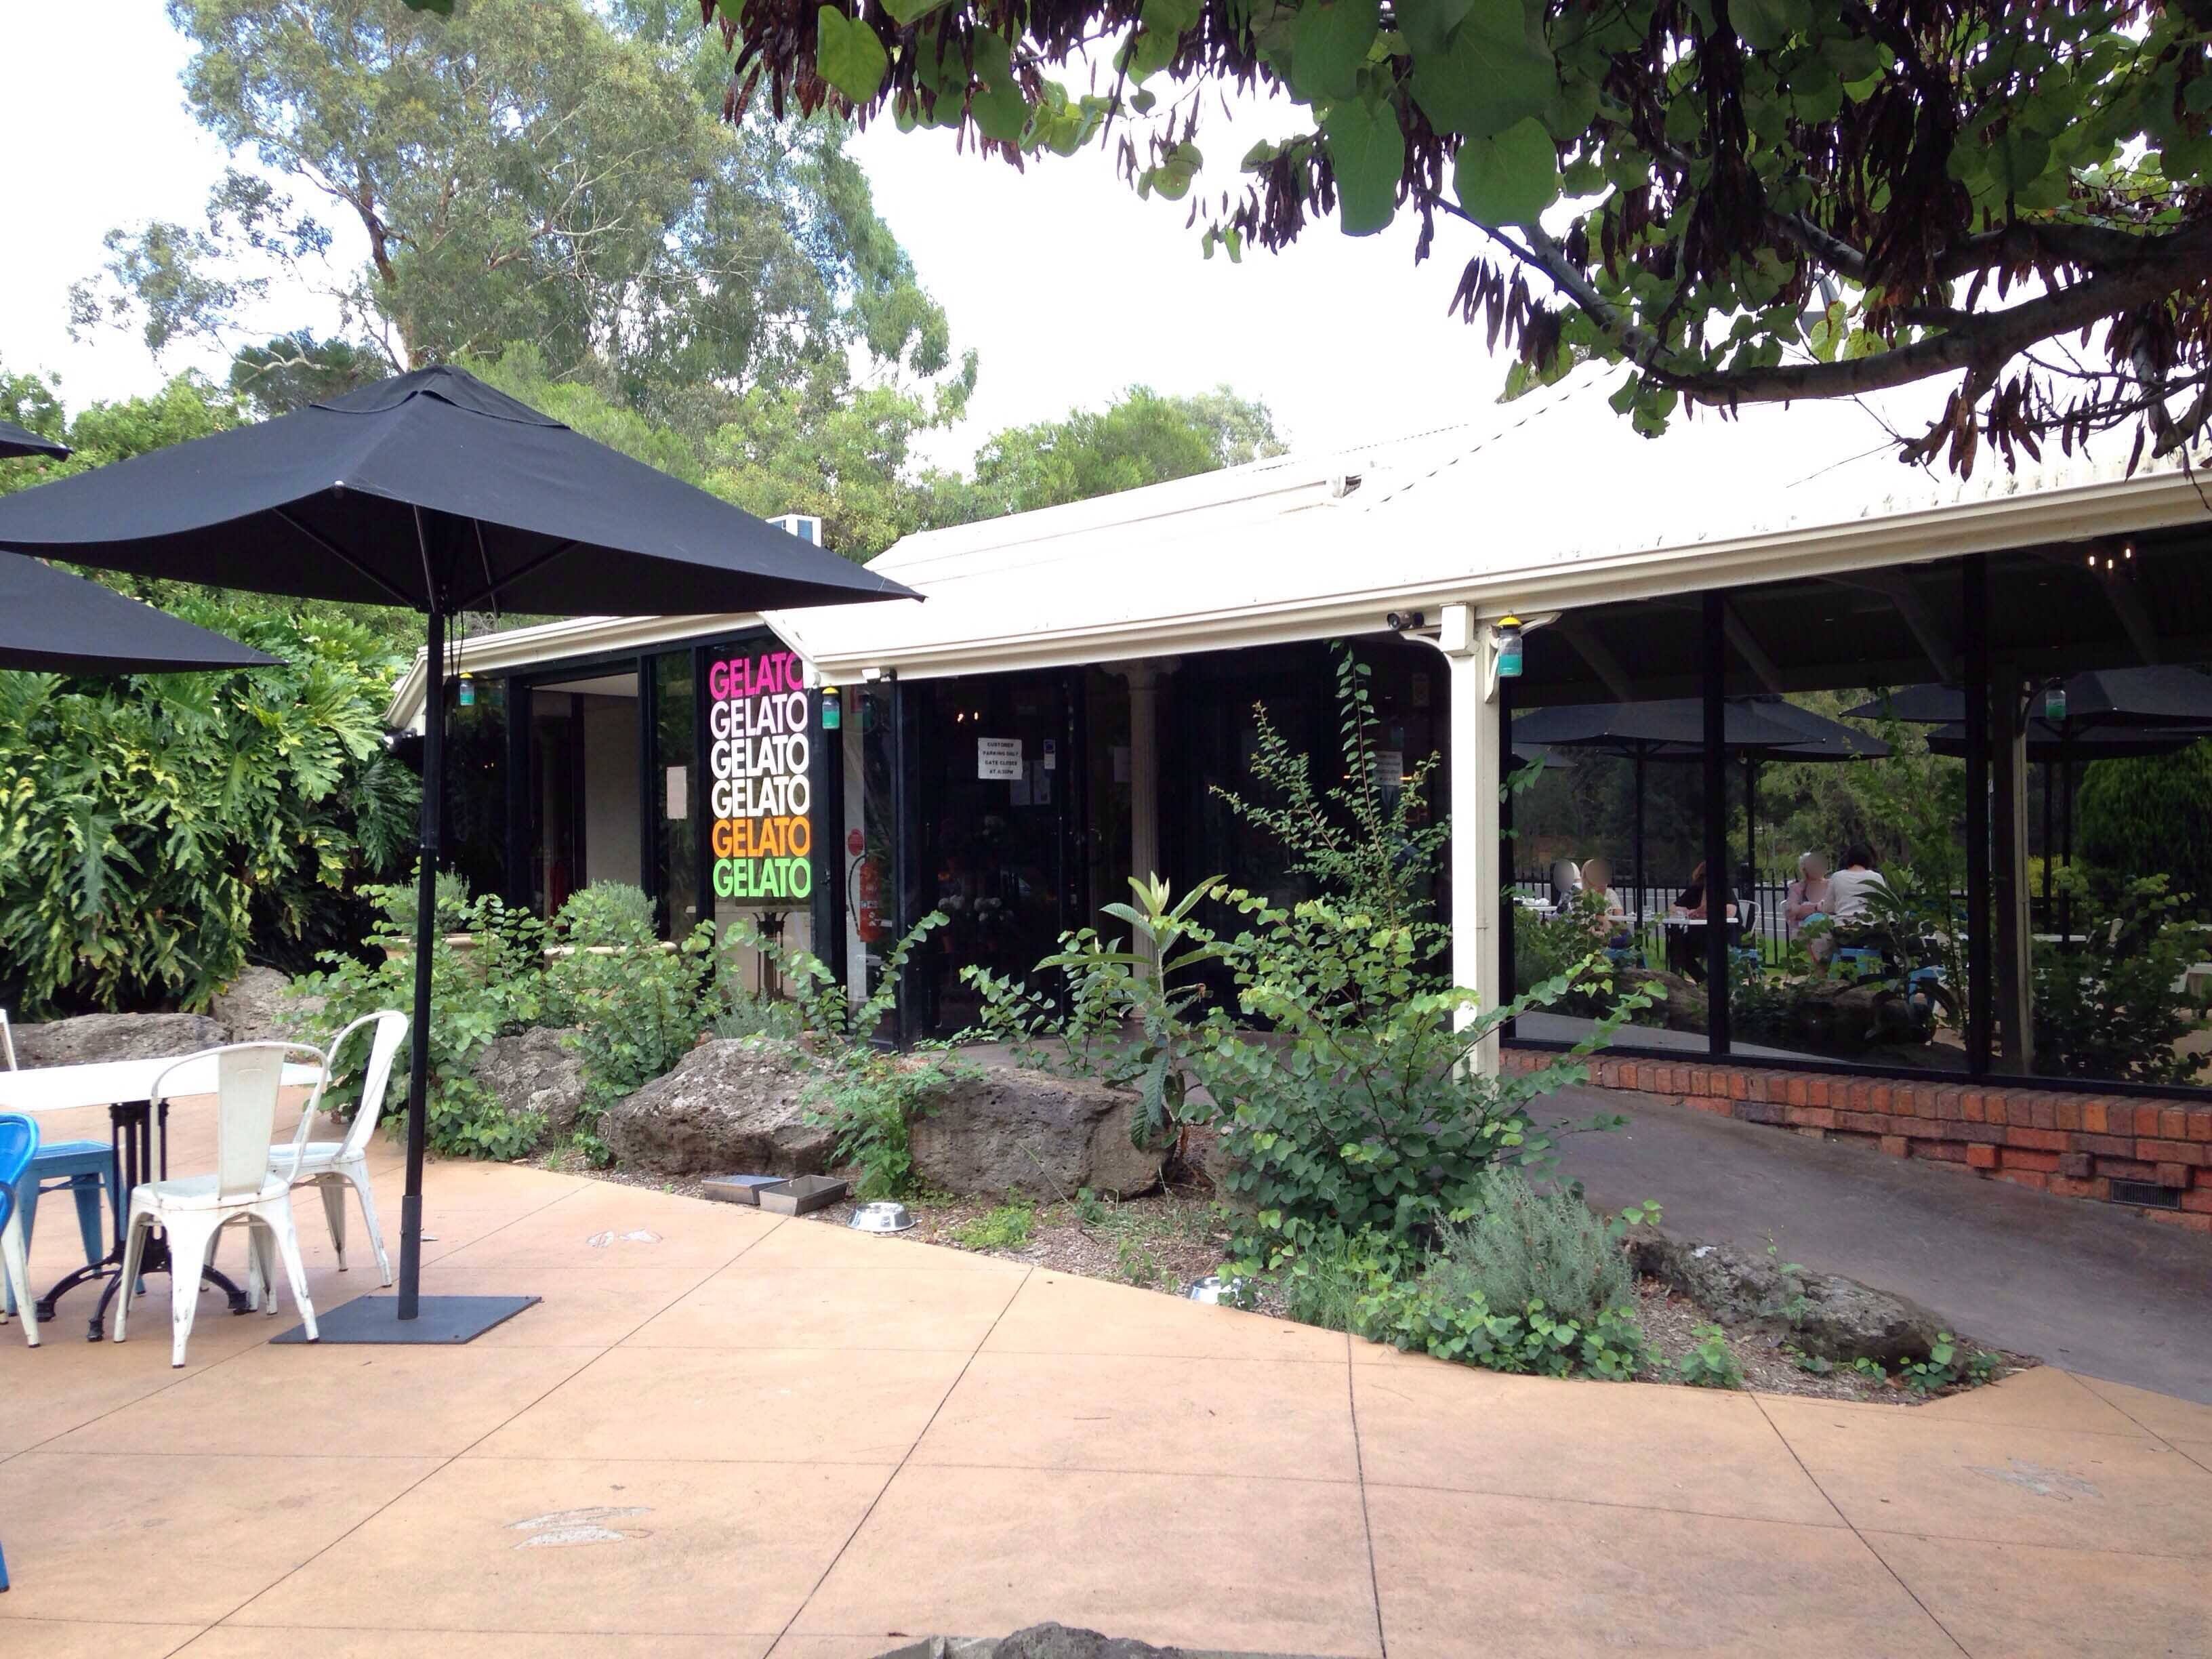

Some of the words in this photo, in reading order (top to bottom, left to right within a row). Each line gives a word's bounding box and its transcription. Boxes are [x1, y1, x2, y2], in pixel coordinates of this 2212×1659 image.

[710, 651, 803, 701] GELATO
[710, 691, 808, 740] GELATO
[711, 733, 809, 779] GELATO
[712, 775, 810, 819] GELATO
[712, 816, 811, 858] GELATO
[713, 857, 811, 898] GELATO
